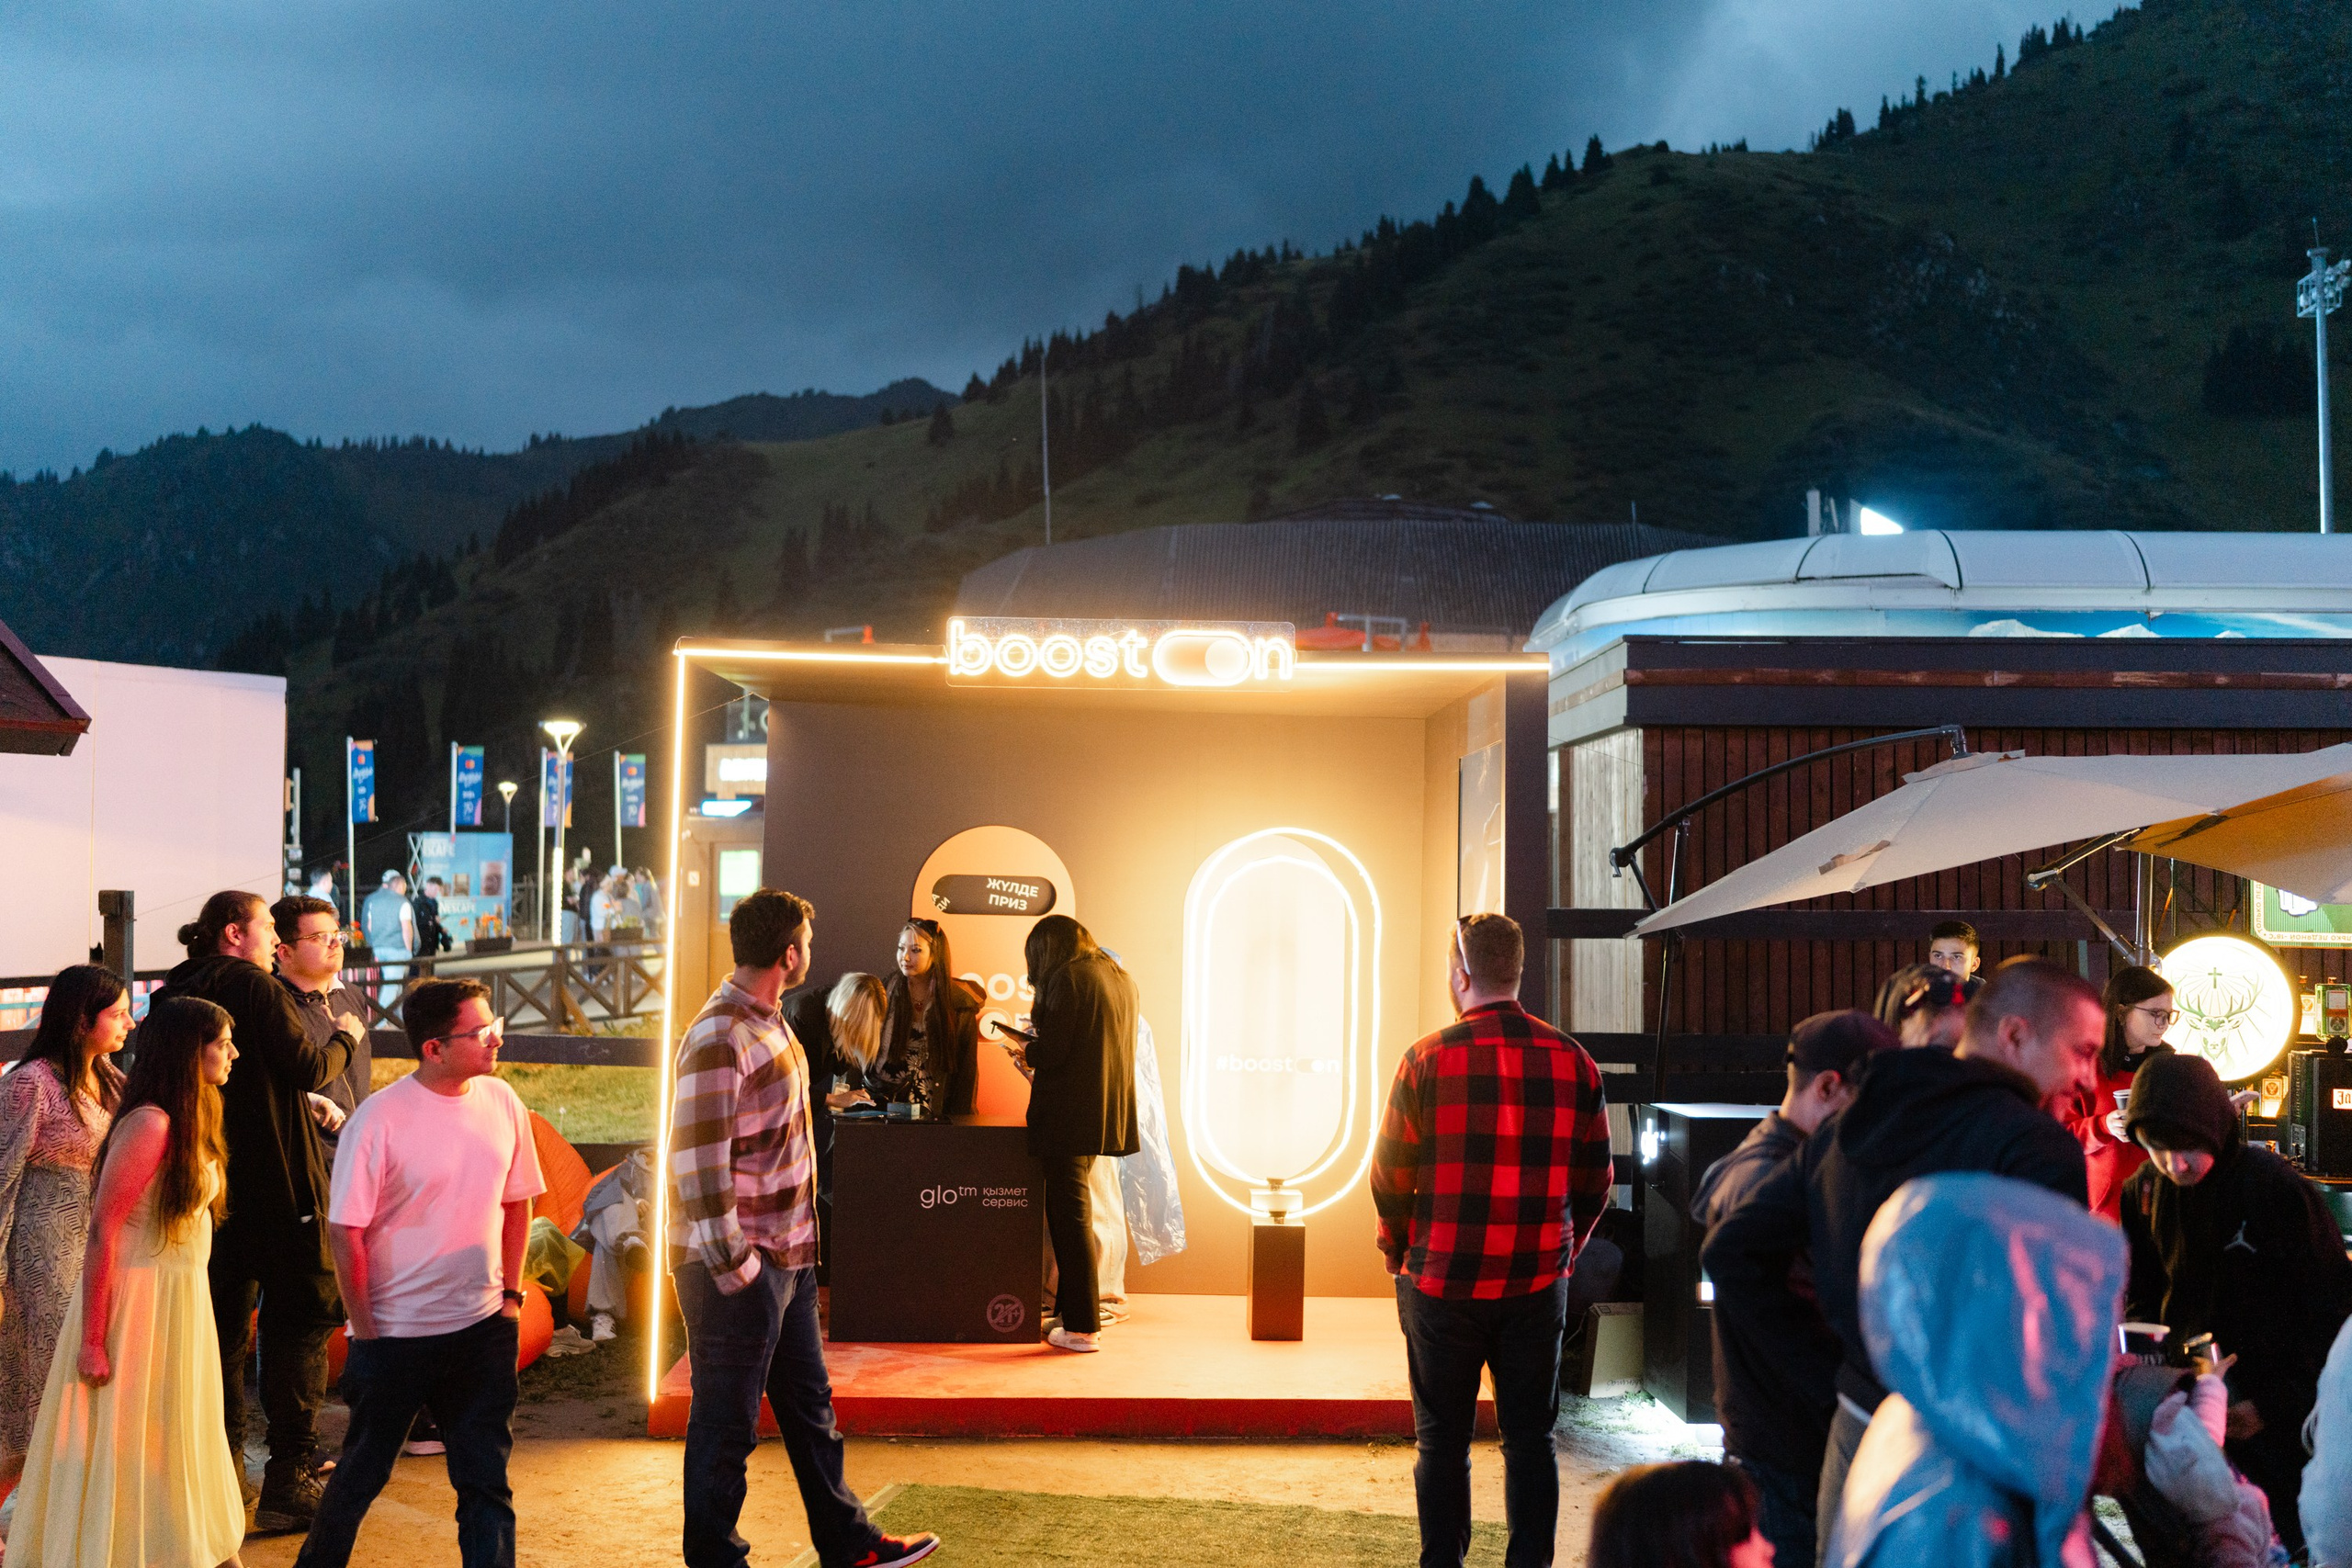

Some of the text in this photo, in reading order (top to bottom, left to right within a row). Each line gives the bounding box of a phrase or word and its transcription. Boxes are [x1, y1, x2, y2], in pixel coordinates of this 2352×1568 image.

[986, 877, 1040, 897] ЖҮЛДЕ
[989, 894, 1028, 910] ПРИЗ
[982, 1187, 1028, 1197] қызмет
[982, 1198, 1028, 1209] сервис
